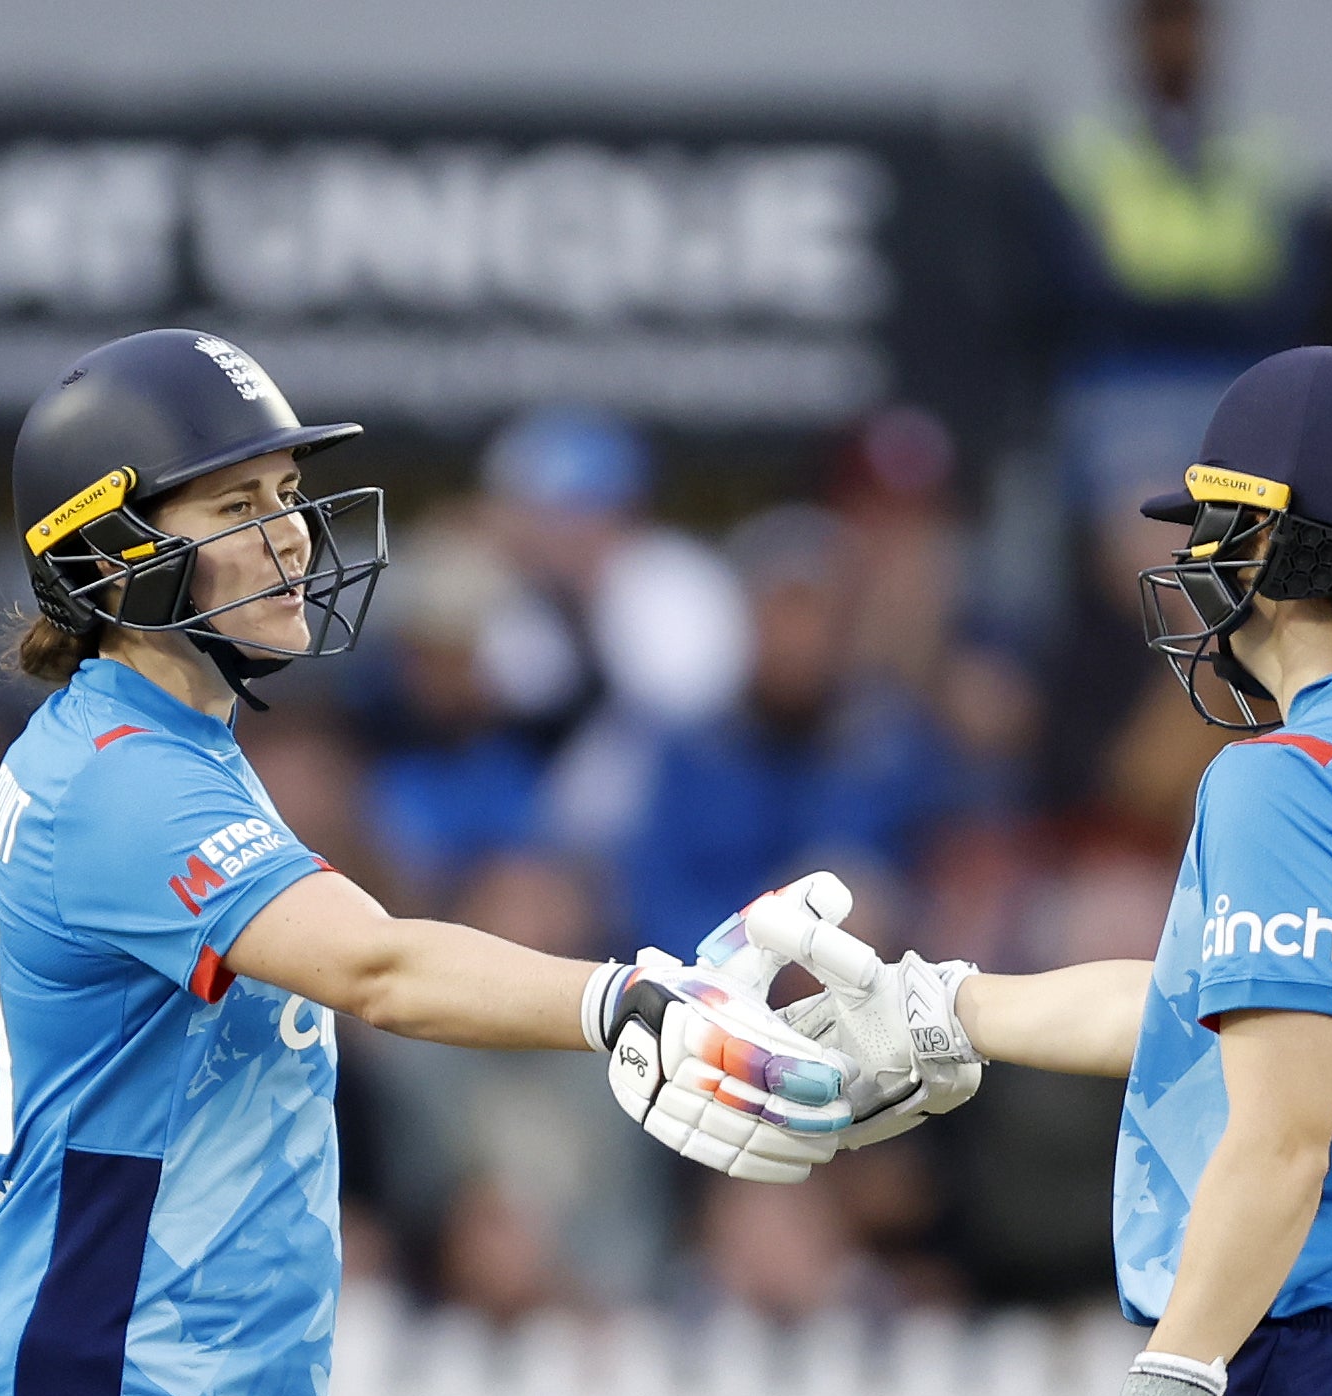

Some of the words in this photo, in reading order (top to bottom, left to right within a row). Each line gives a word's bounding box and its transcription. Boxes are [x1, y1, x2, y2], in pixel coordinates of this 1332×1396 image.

[1202, 474, 1252, 492] MASURI
[54, 485, 107, 526] MASURI
[168, 818, 271, 917] METRO
[221, 834, 288, 878] BANK
